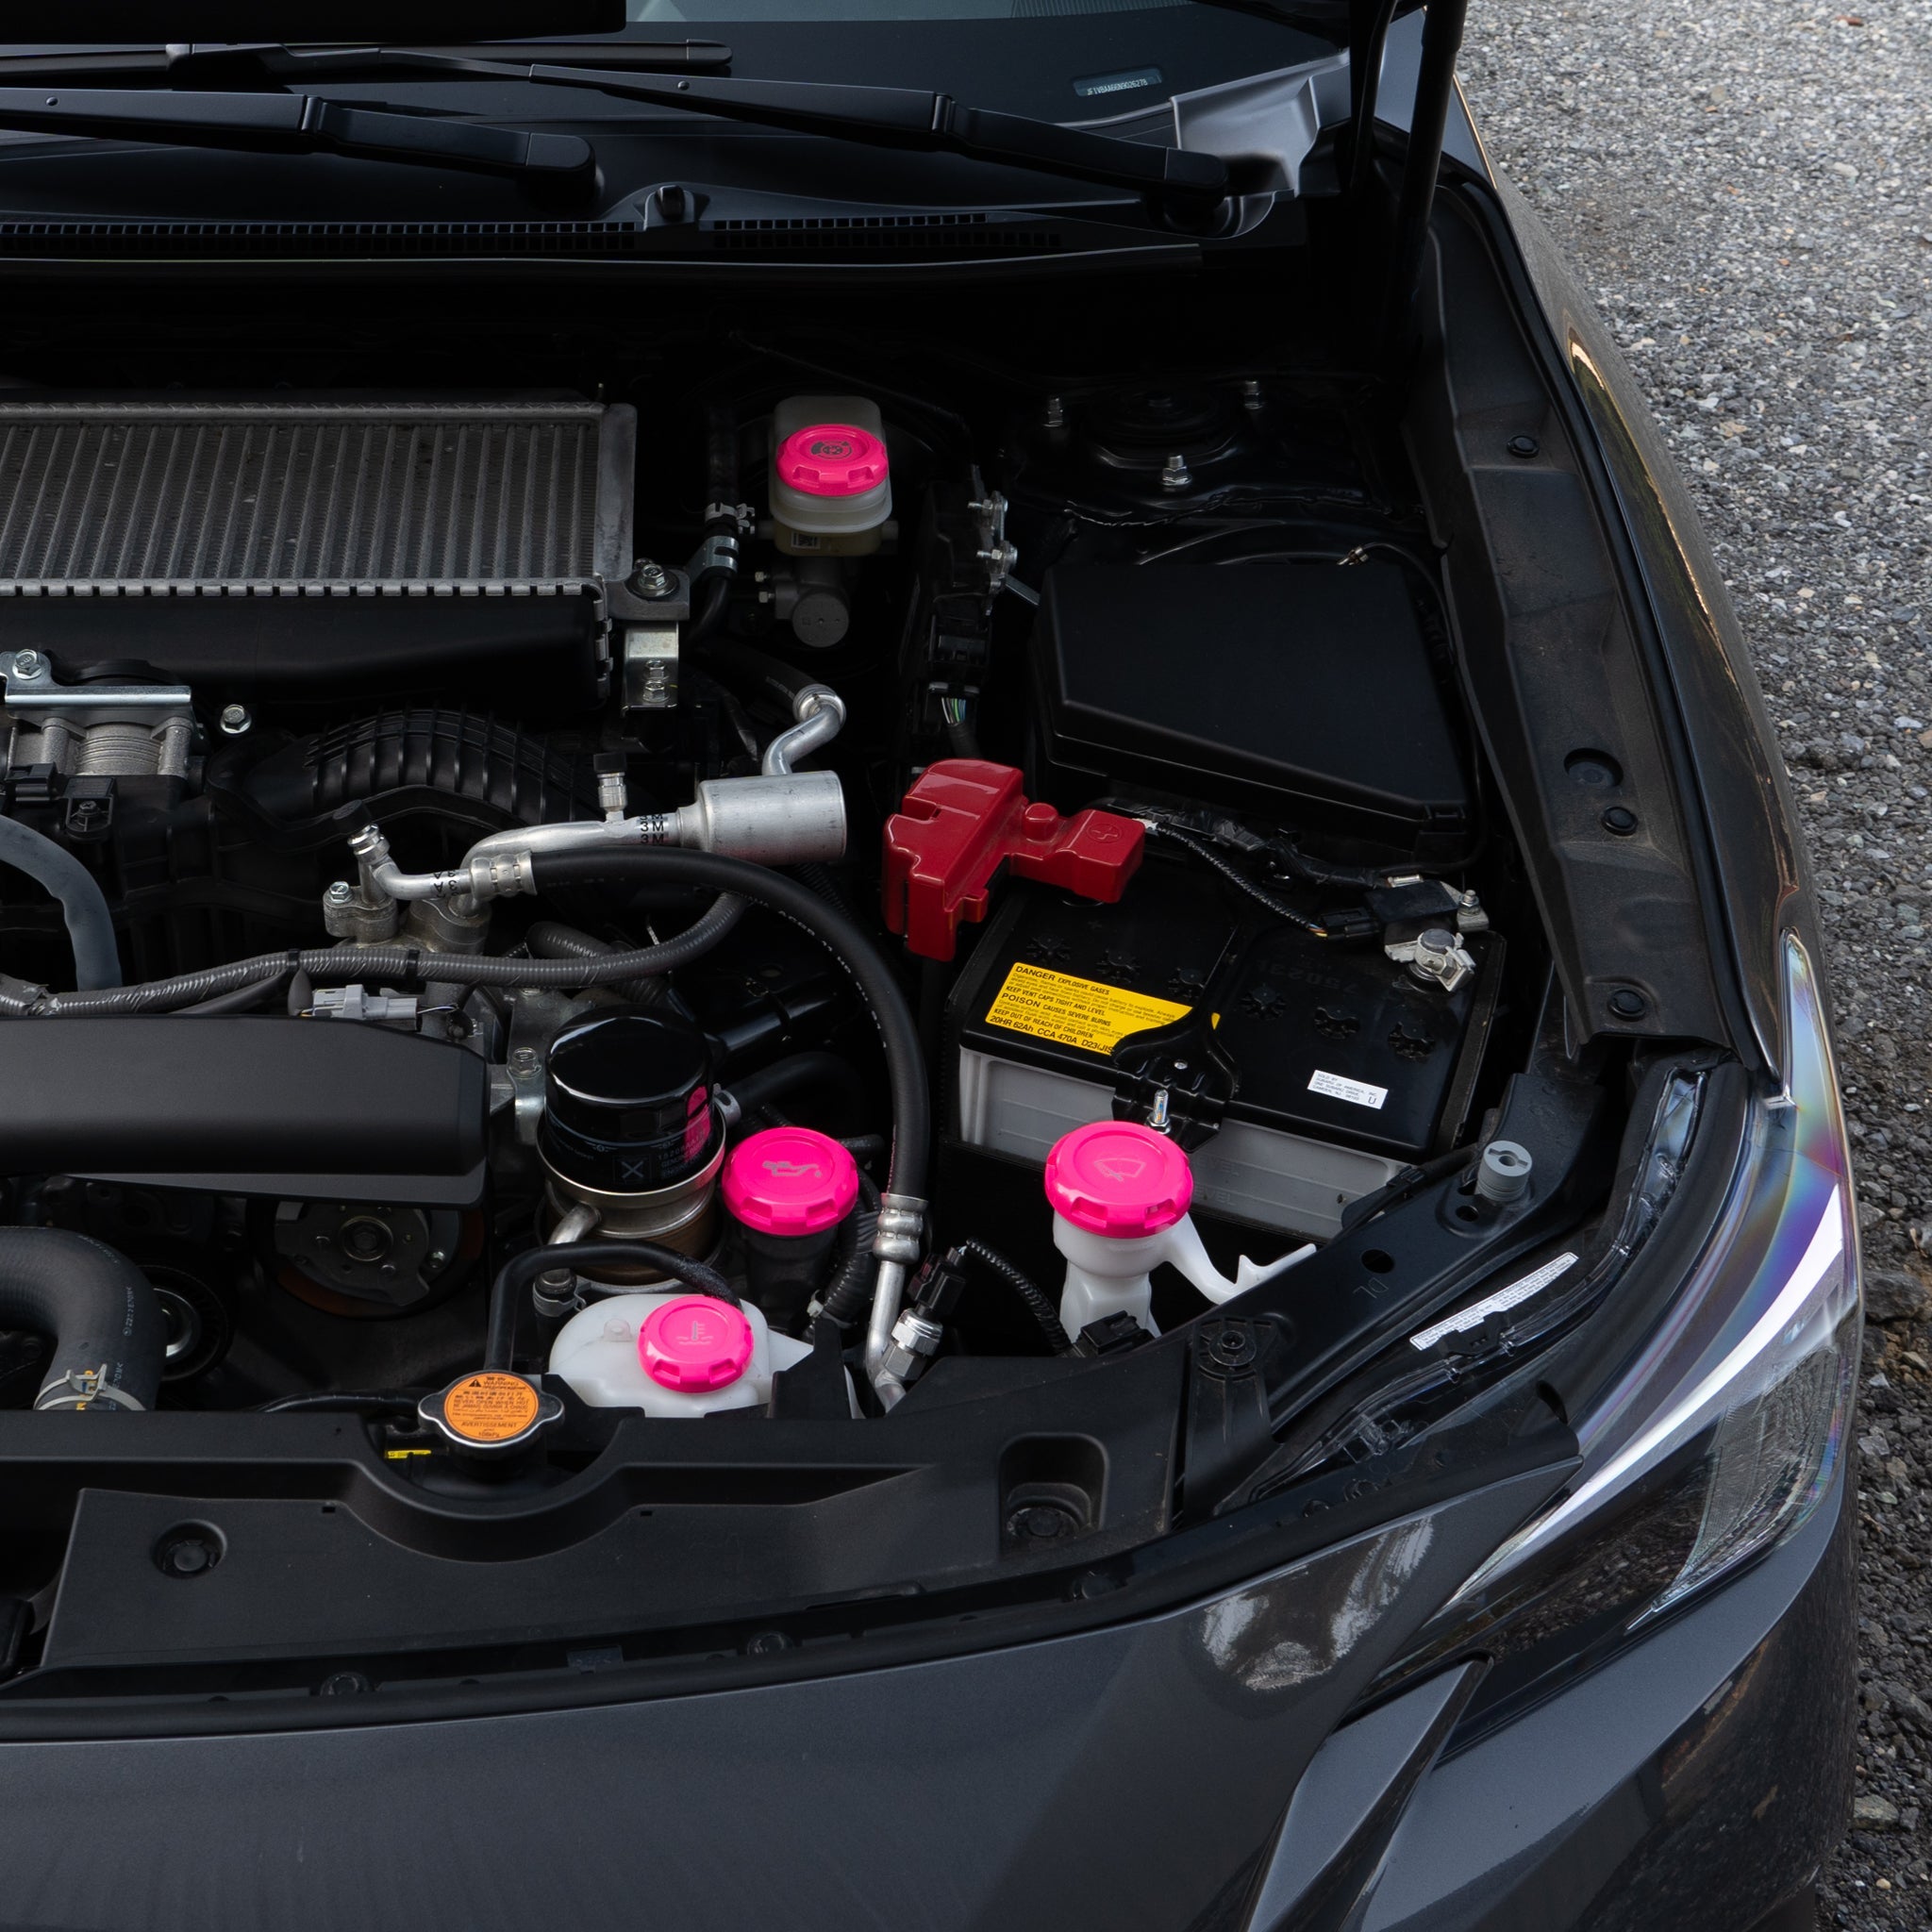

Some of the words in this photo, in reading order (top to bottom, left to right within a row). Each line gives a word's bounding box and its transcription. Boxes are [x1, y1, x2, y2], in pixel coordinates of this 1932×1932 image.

[1016, 966, 1055, 980] DANGER
[1058, 977, 1089, 990] EXPLOSIVE
[1090, 986, 1109, 995] GASES
[1002, 992, 1041, 1008] POISON
[1042, 1005, 1066, 1014] CAUSES
[1067, 1010, 1090, 1021] SEVERE
[1091, 1017, 1111, 1026] BURNS
[1056, 998, 1073, 1007] TIGHT
[1087, 1007, 1106, 1015] LEVEL
[990, 1015, 1012, 1026] 20HR
[1013, 1022, 1034, 1032] 62Ah
[1037, 1027, 1056, 1038] CCA
[1057, 1033, 1077, 1043] 470A
[1032, 1019, 1053, 1027] REACH
[1063, 1026, 1094, 1039] CHILDREN
[1368, 1096, 1376, 1105] U
